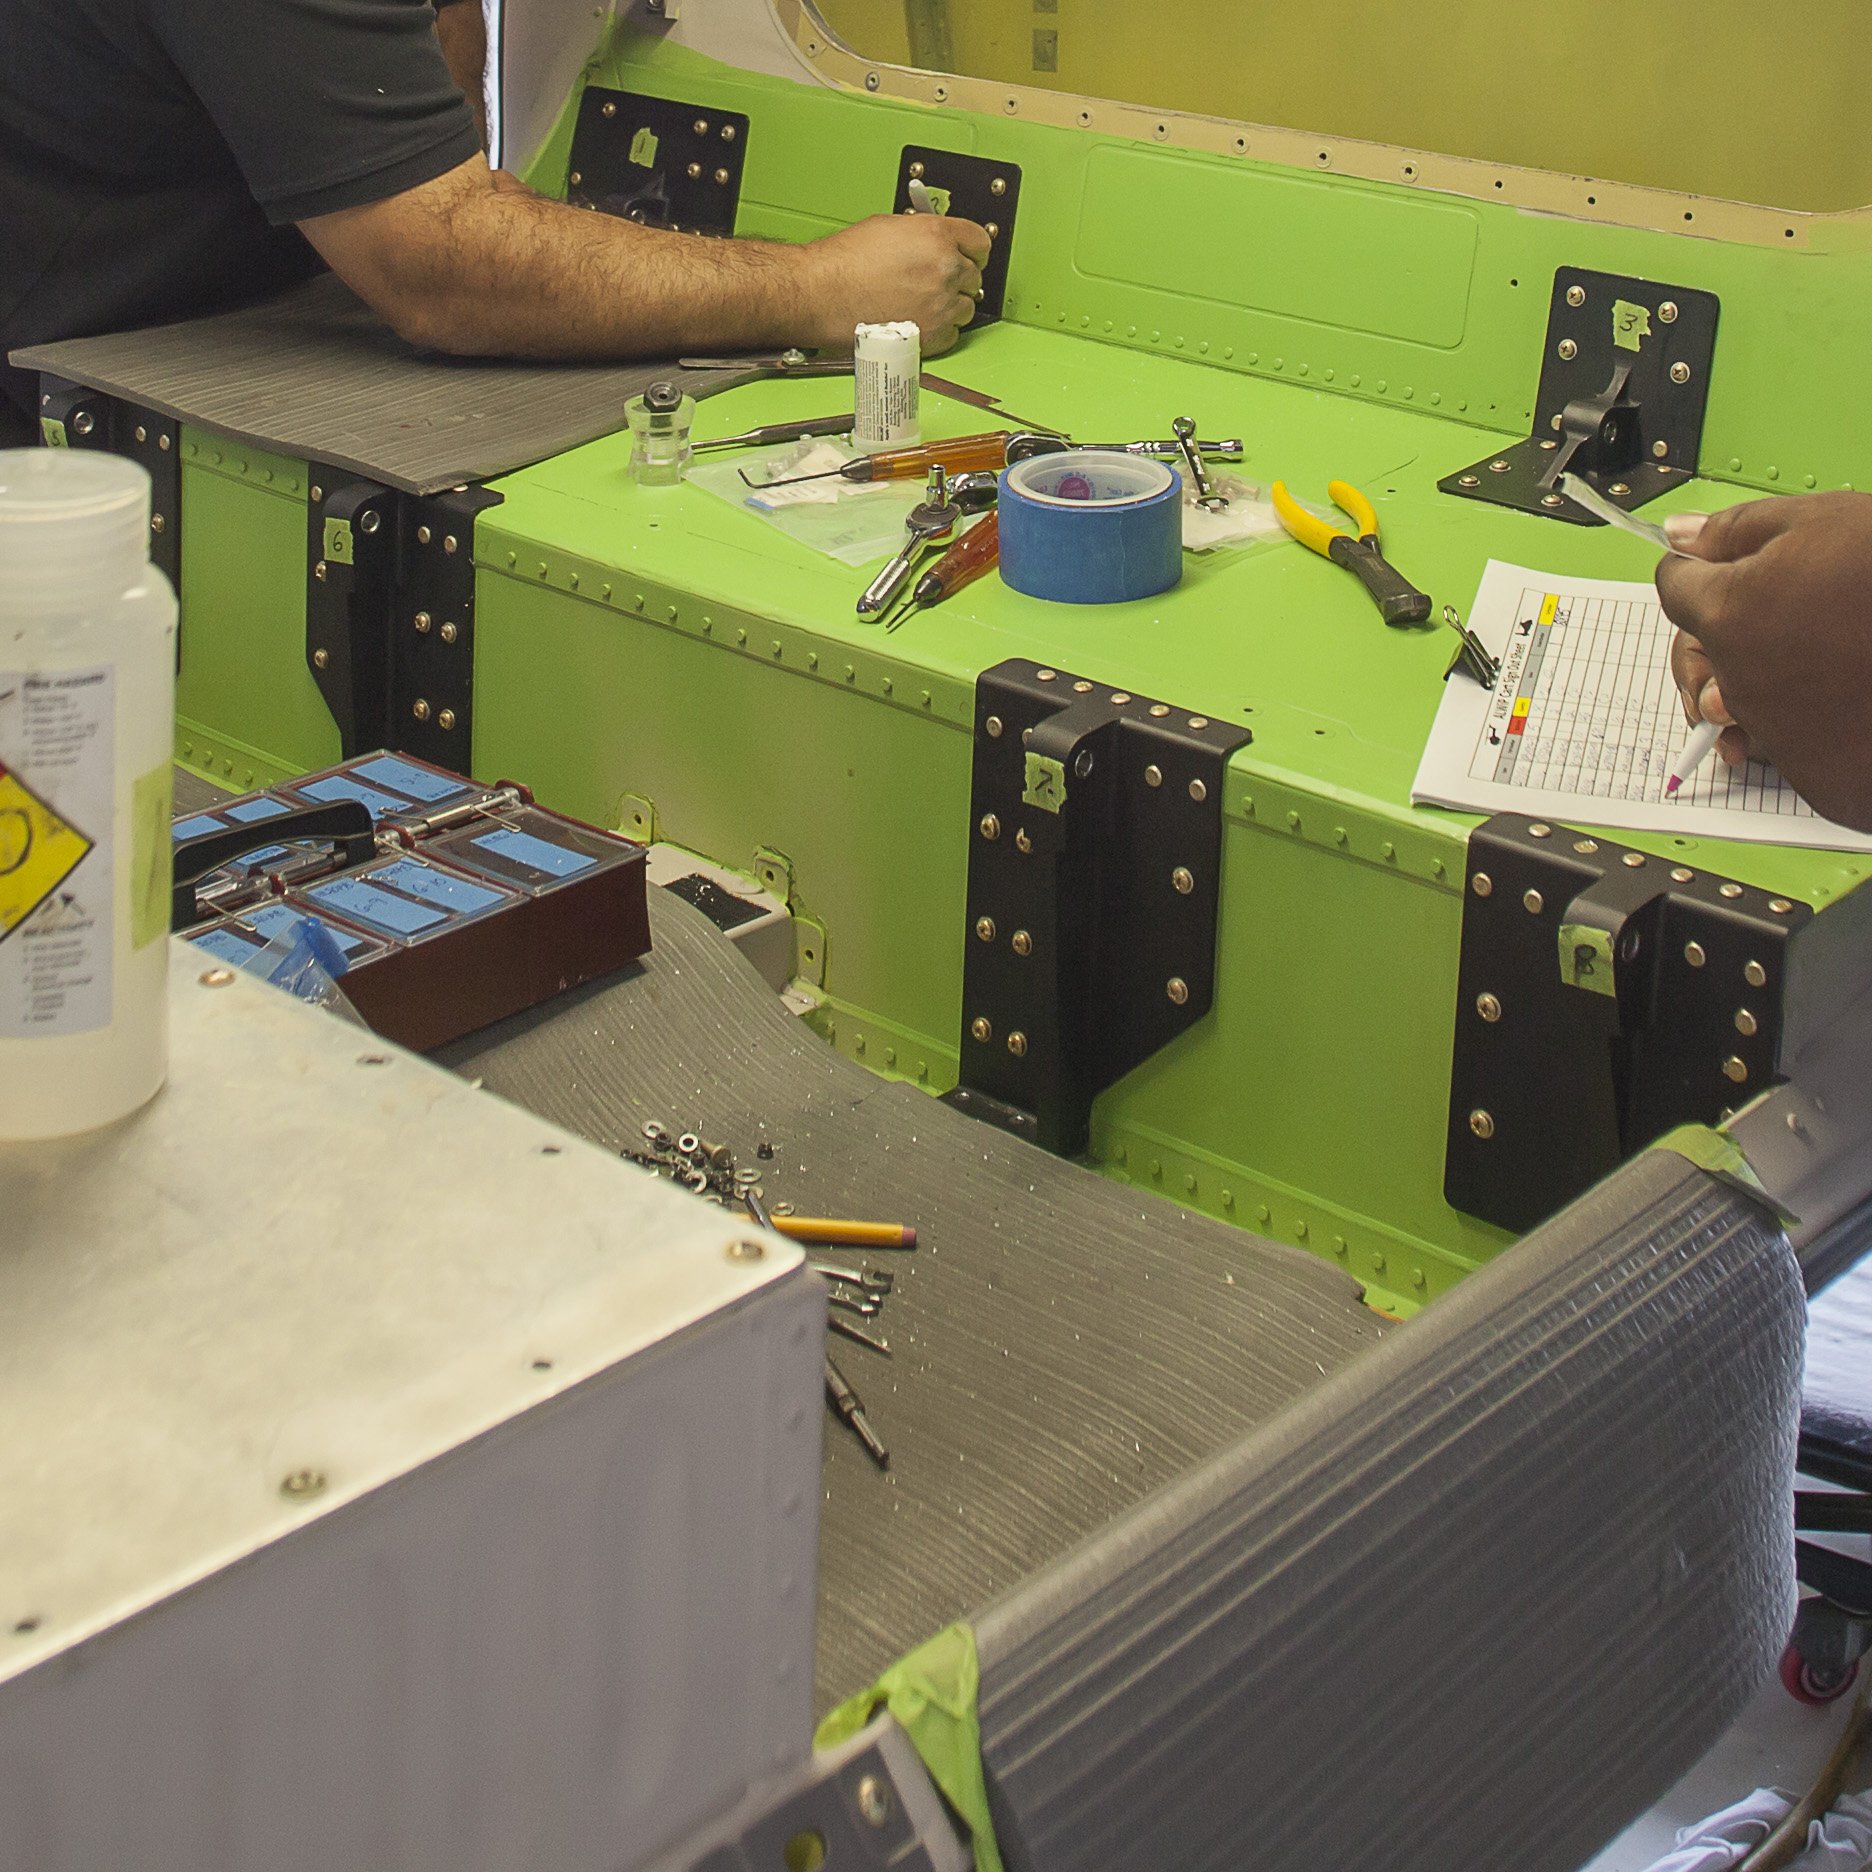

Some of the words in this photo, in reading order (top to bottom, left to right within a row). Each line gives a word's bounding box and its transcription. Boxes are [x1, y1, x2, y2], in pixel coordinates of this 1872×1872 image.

[1619, 312, 1639, 332] 3
[332, 530, 343, 553] 6
[1510, 642, 1526, 660] Sheet
[1502, 671, 1521, 684] Sign
[1499, 684, 1514, 698] Cart
[1034, 767, 1054, 792] 7
